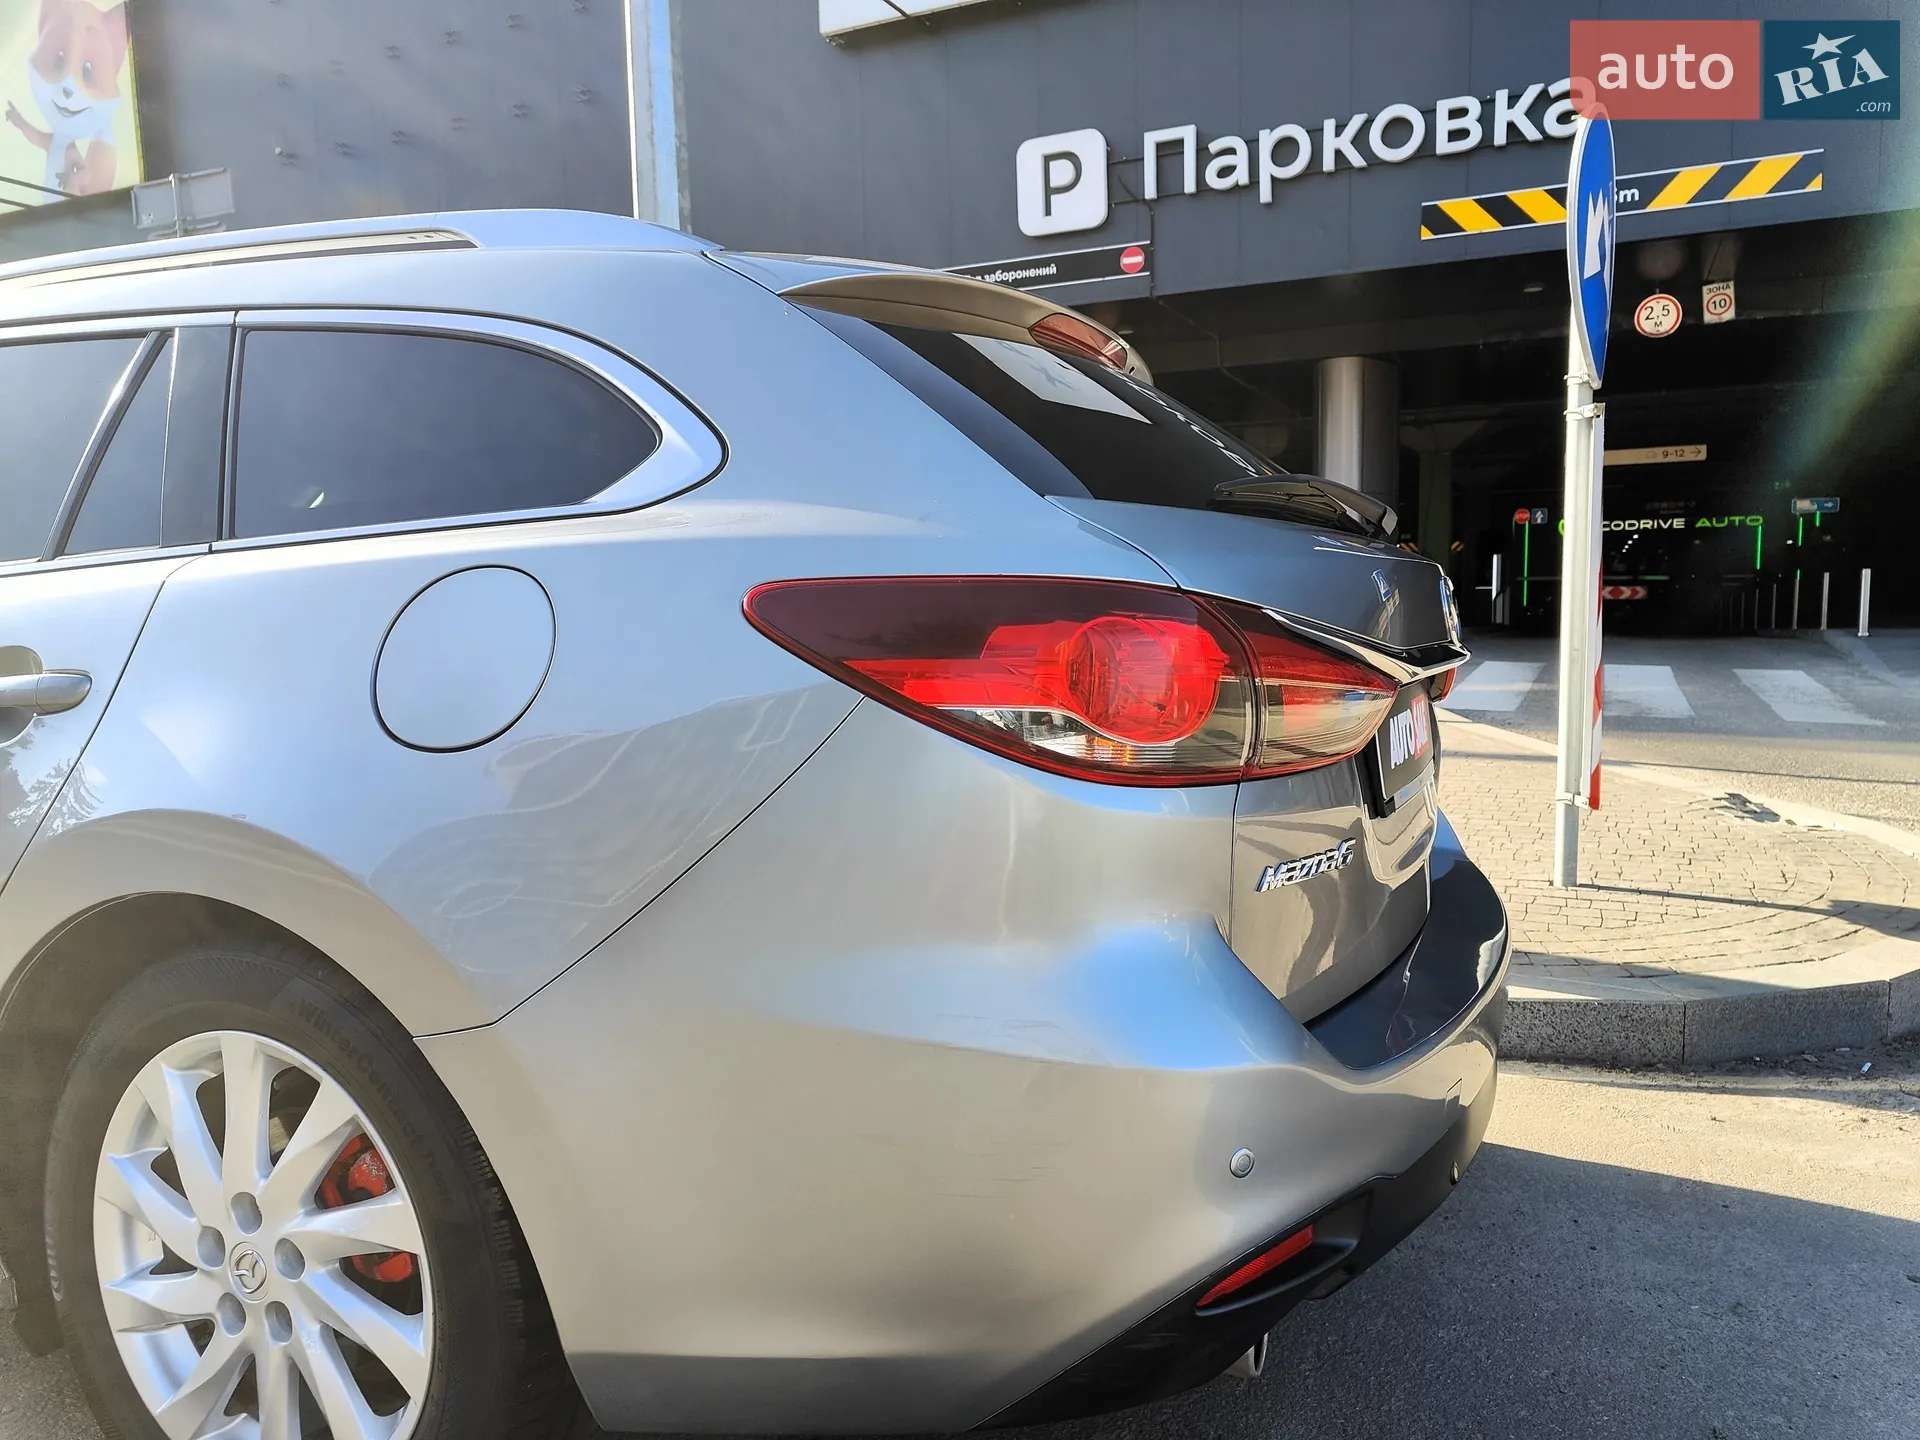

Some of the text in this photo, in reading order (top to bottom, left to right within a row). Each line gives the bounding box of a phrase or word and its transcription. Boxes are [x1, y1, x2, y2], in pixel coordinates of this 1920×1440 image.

[1143, 76, 1597, 204] Парковка
[984, 263, 1057, 283] заборонений
[1706, 284, 1732, 295] ЗОНА
[1711, 298, 1727, 311] 10
[1644, 304, 1671, 320] 2,5
[1662, 449, 1685, 459] 9-12
[1695, 515, 1764, 528] AUTO
